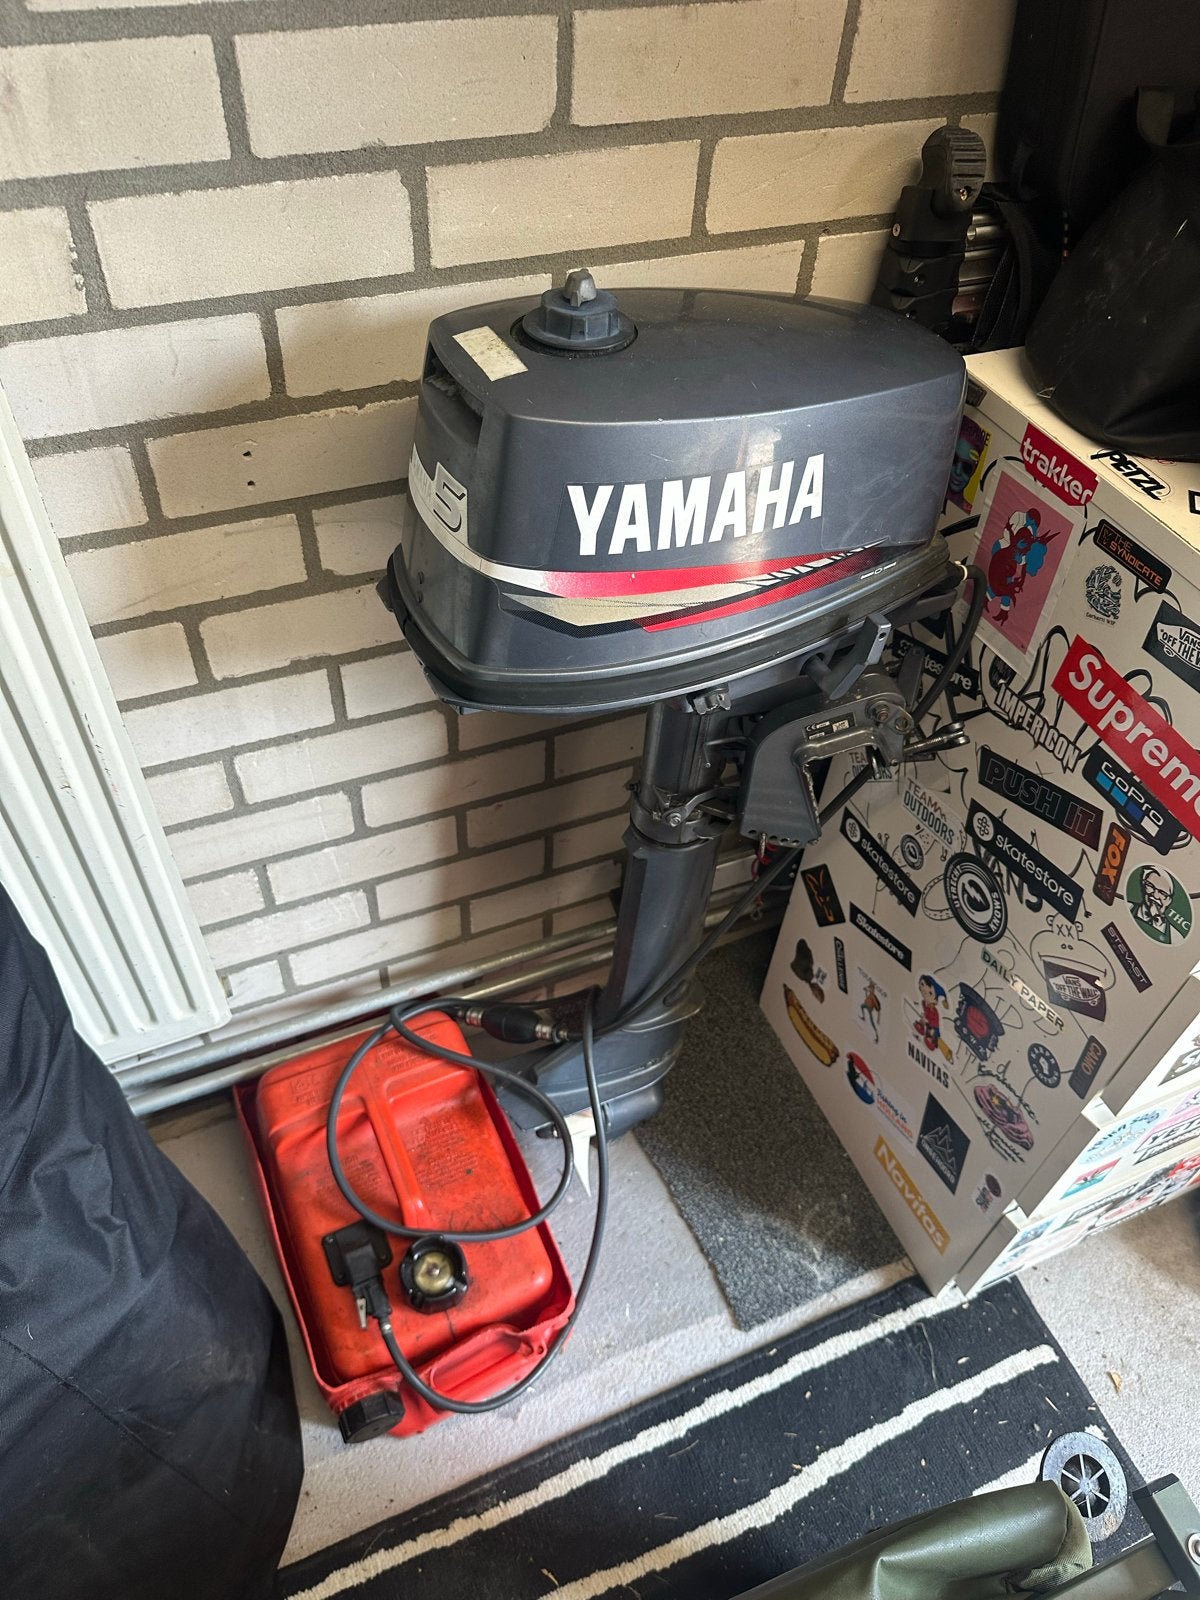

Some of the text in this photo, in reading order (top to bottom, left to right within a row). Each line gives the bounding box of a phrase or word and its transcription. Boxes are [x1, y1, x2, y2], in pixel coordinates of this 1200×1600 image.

[433, 461, 467, 533] 5
[1023, 437, 1093, 504] trakker
[1090, 449, 1166, 501] PETZL
[566, 453, 825, 556] YAMAHA
[1109, 541, 1163, 586] SYNDICATE
[1178, 640, 1197, 663] THE
[994, 682, 1083, 773] IMPERICON
[903, 790, 955, 846] OUTDOORS
[985, 757, 1096, 838] PUSH IT
[860, 838, 916, 904] skatestore
[995, 833, 1075, 907] skatestore
[1101, 829, 1126, 885] FOX
[950, 864, 962, 908] UTRECHT
[988, 891, 1002, 932] KNOWS
[1167, 908, 1191, 931] THC
[1107, 926, 1148, 984] STEVAST
[982, 950, 1018, 986] DAILY
[1020, 986, 1064, 1031] PAPER
[908, 1041, 949, 1088] NAVITAS
[877, 1143, 944, 1250] Navitas
